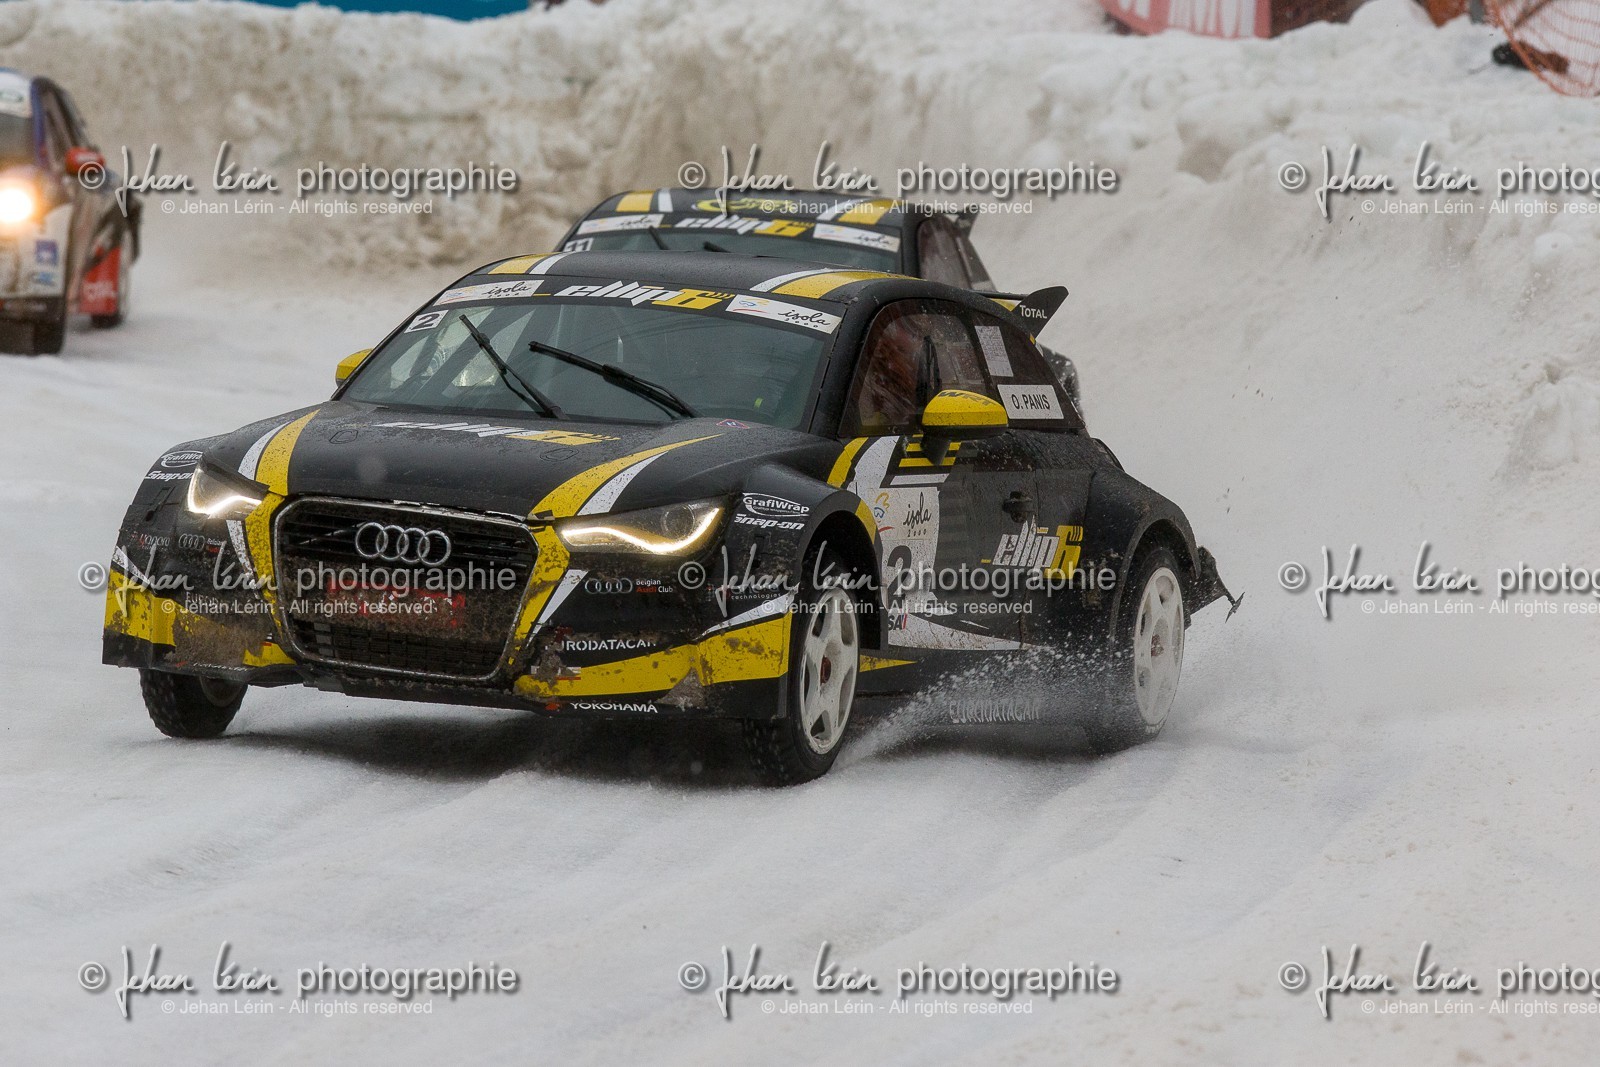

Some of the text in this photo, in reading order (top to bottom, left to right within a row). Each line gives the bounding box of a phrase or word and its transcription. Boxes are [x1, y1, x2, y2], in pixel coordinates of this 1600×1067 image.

[481, 281, 532, 296] isola
[777, 309, 831, 326] isola
[1019, 305, 1048, 319] TOTAL
[410, 313, 441, 331] 2
[1011, 394, 1051, 411] O. PANIS
[742, 496, 810, 514] GrafiWrap
[903, 491, 932, 529] isola
[886, 544, 912, 601] 2
[635, 578, 662, 587] Belgian
[657, 585, 674, 593] Club
[570, 701, 659, 714] YOKOHAMA
